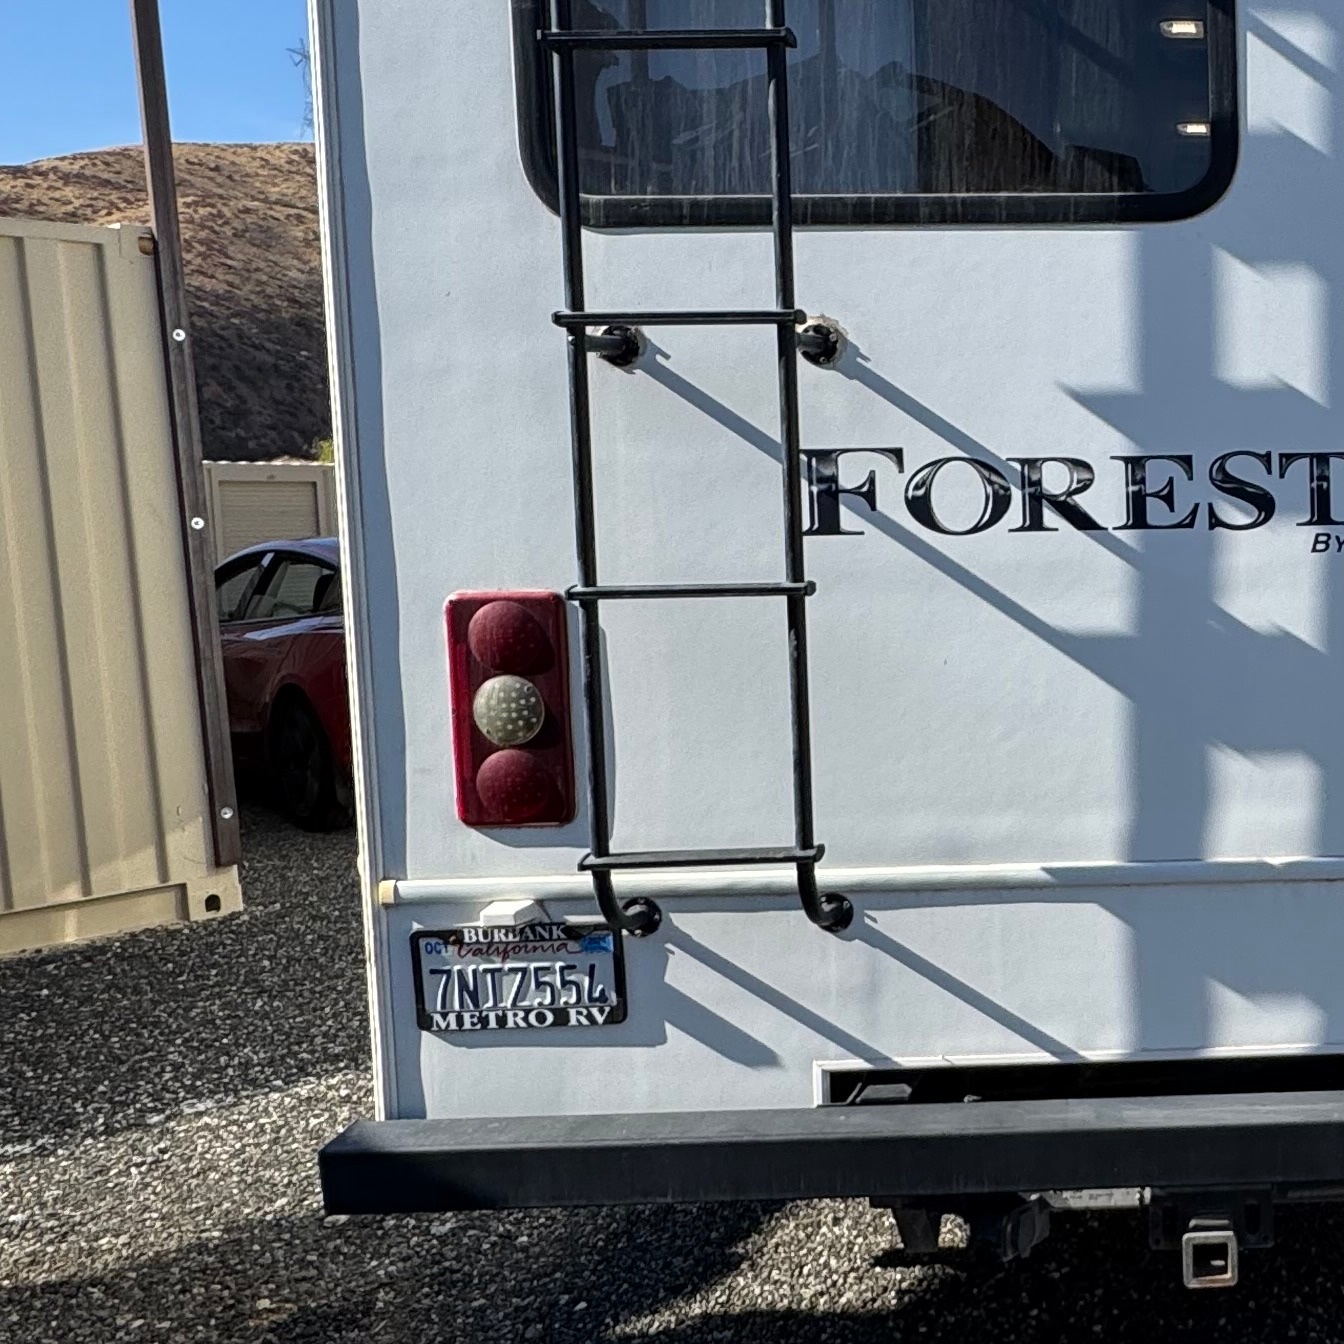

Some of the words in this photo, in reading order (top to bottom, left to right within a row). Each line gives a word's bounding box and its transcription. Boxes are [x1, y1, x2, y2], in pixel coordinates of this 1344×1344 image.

[463, 925, 568, 944] BURBANK
[456, 941, 582, 963] California
[430, 1008, 555, 1032] METRO
[568, 1006, 612, 1026] RV
